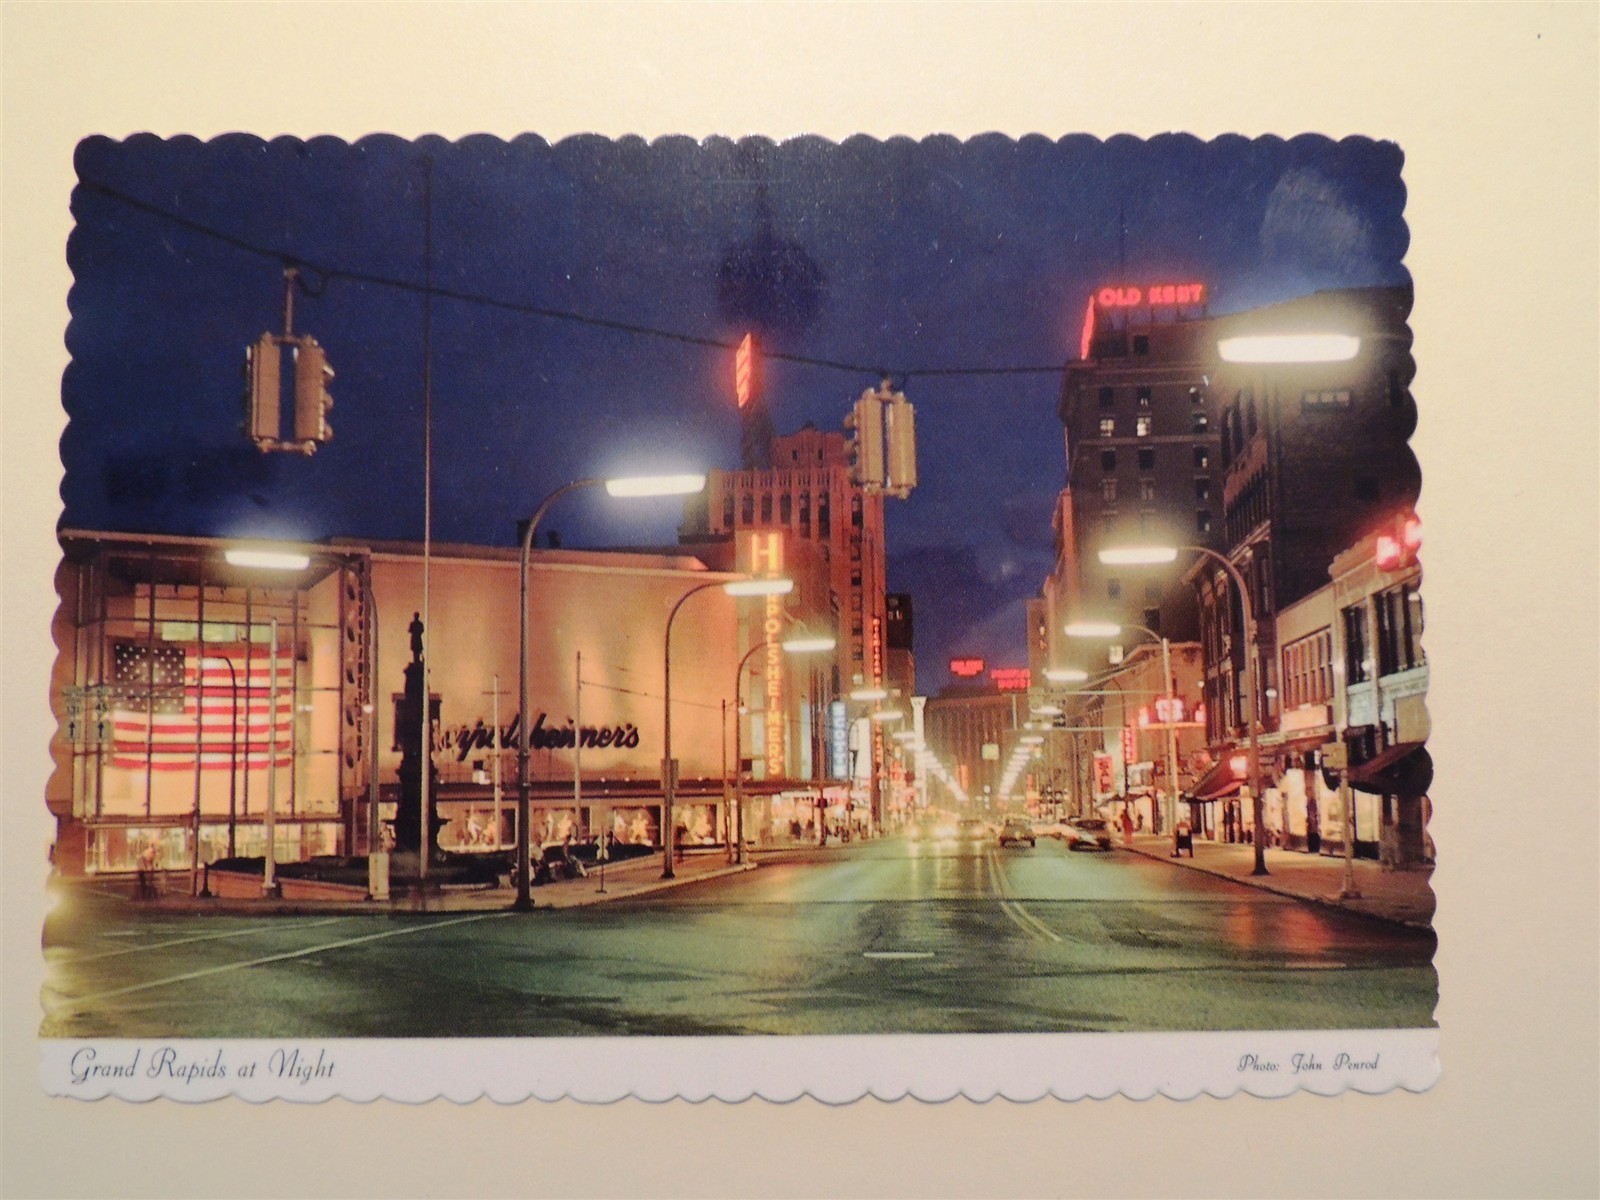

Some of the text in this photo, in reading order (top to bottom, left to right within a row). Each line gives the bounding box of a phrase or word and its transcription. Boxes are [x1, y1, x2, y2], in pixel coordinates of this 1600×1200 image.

[1098, 284, 1203, 306] OLD KENT
[70, 1047, 336, 1085] Grand Rapids at Night
[1237, 1052, 1380, 1075] Photo: John Penrod
